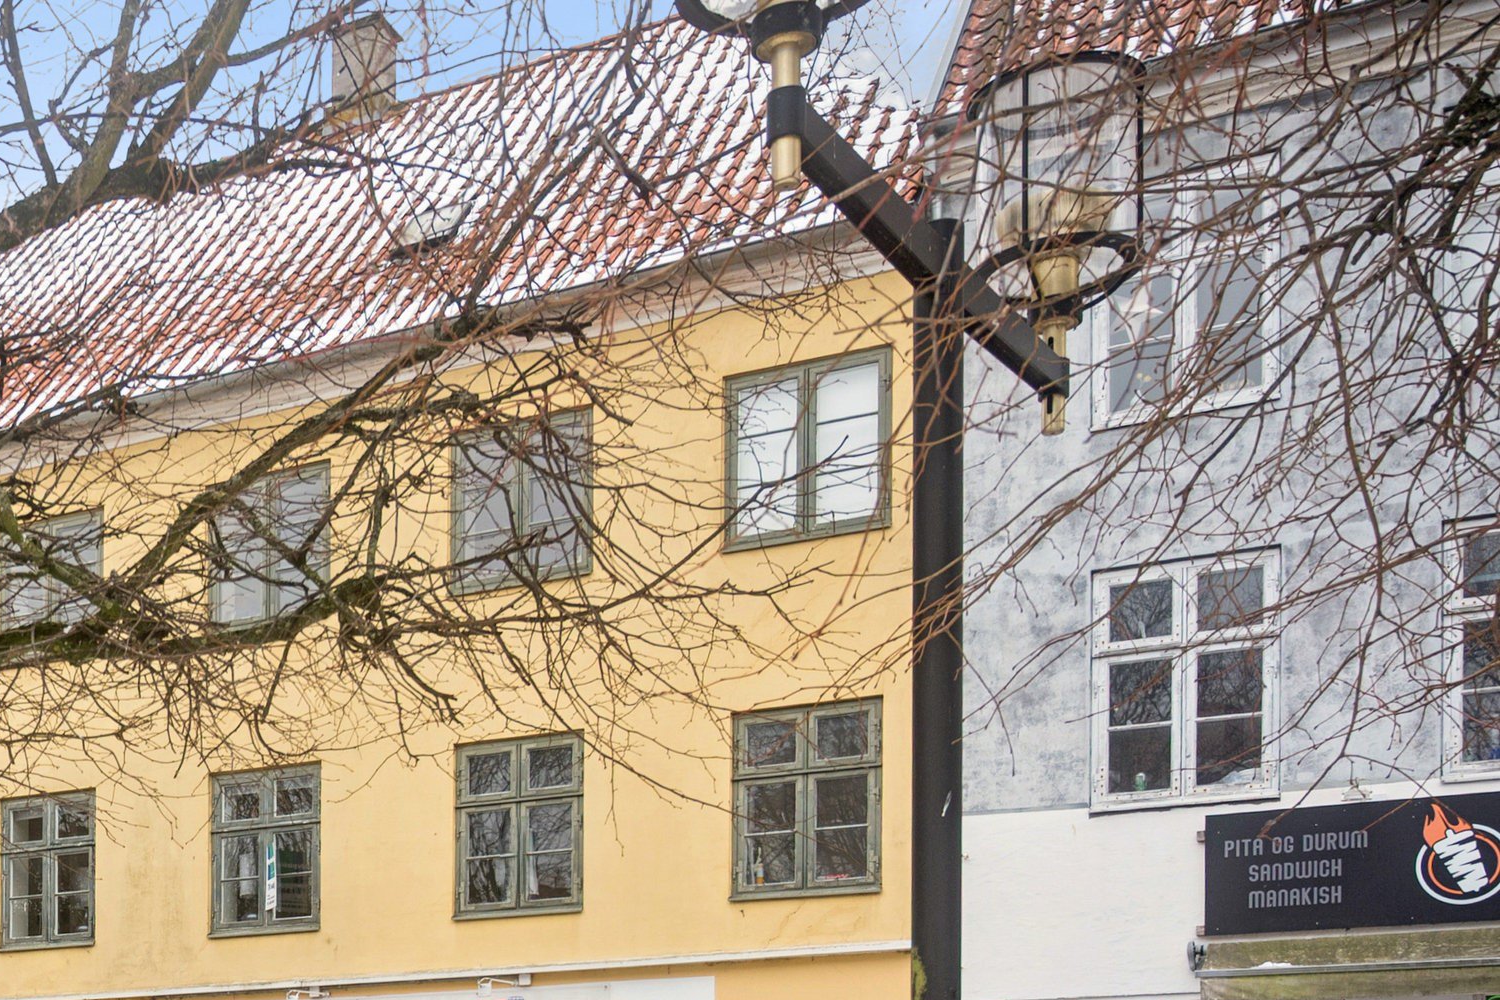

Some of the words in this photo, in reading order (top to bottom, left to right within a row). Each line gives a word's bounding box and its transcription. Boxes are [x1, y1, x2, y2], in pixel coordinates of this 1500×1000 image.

[1224, 838, 1264, 858] PITA
[1272, 836, 1294, 854] OG
[1303, 830, 1369, 852] DURUM
[1249, 859, 1343, 883] SANDWICH
[1248, 885, 1343, 909] MANAKISH
